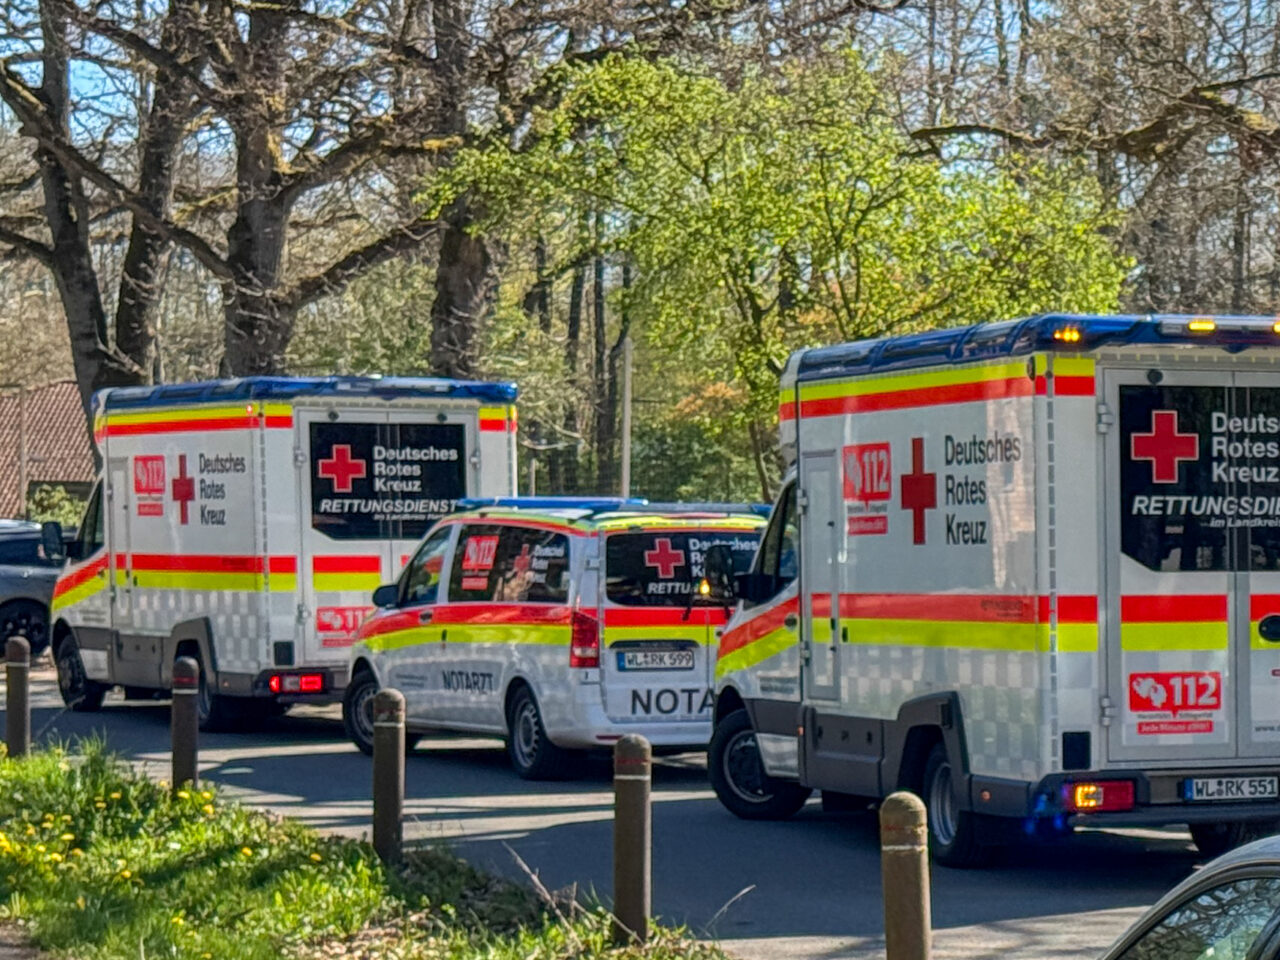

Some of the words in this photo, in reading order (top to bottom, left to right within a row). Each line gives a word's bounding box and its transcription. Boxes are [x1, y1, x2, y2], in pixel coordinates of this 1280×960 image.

[373, 445, 458, 461] Deutsches
[945, 431, 1021, 466] Deutsches
[1212, 437, 1280, 458] Rotes
[199, 453, 246, 474] Deutsches
[373, 461, 422, 477] Rotes
[863, 450, 889, 493] 112
[1212, 461, 1280, 483] Kreuz
[200, 478, 226, 500] Rotes
[373, 477, 422, 492] Kreuz
[945, 475, 986, 505] Rotes
[200, 503, 227, 526] Kreuz
[320, 498, 458, 514] RETTUNGSDIENST
[945, 514, 987, 545] Kreuz
[1209, 517, 1225, 528] im
[669, 652, 692, 666] 599
[442, 669, 493, 692] NOTARZT
[1169, 676, 1218, 706] 112
[1195, 780, 1215, 797] WL
[1225, 780, 1245, 796] RK
[1249, 779, 1277, 795] 551
